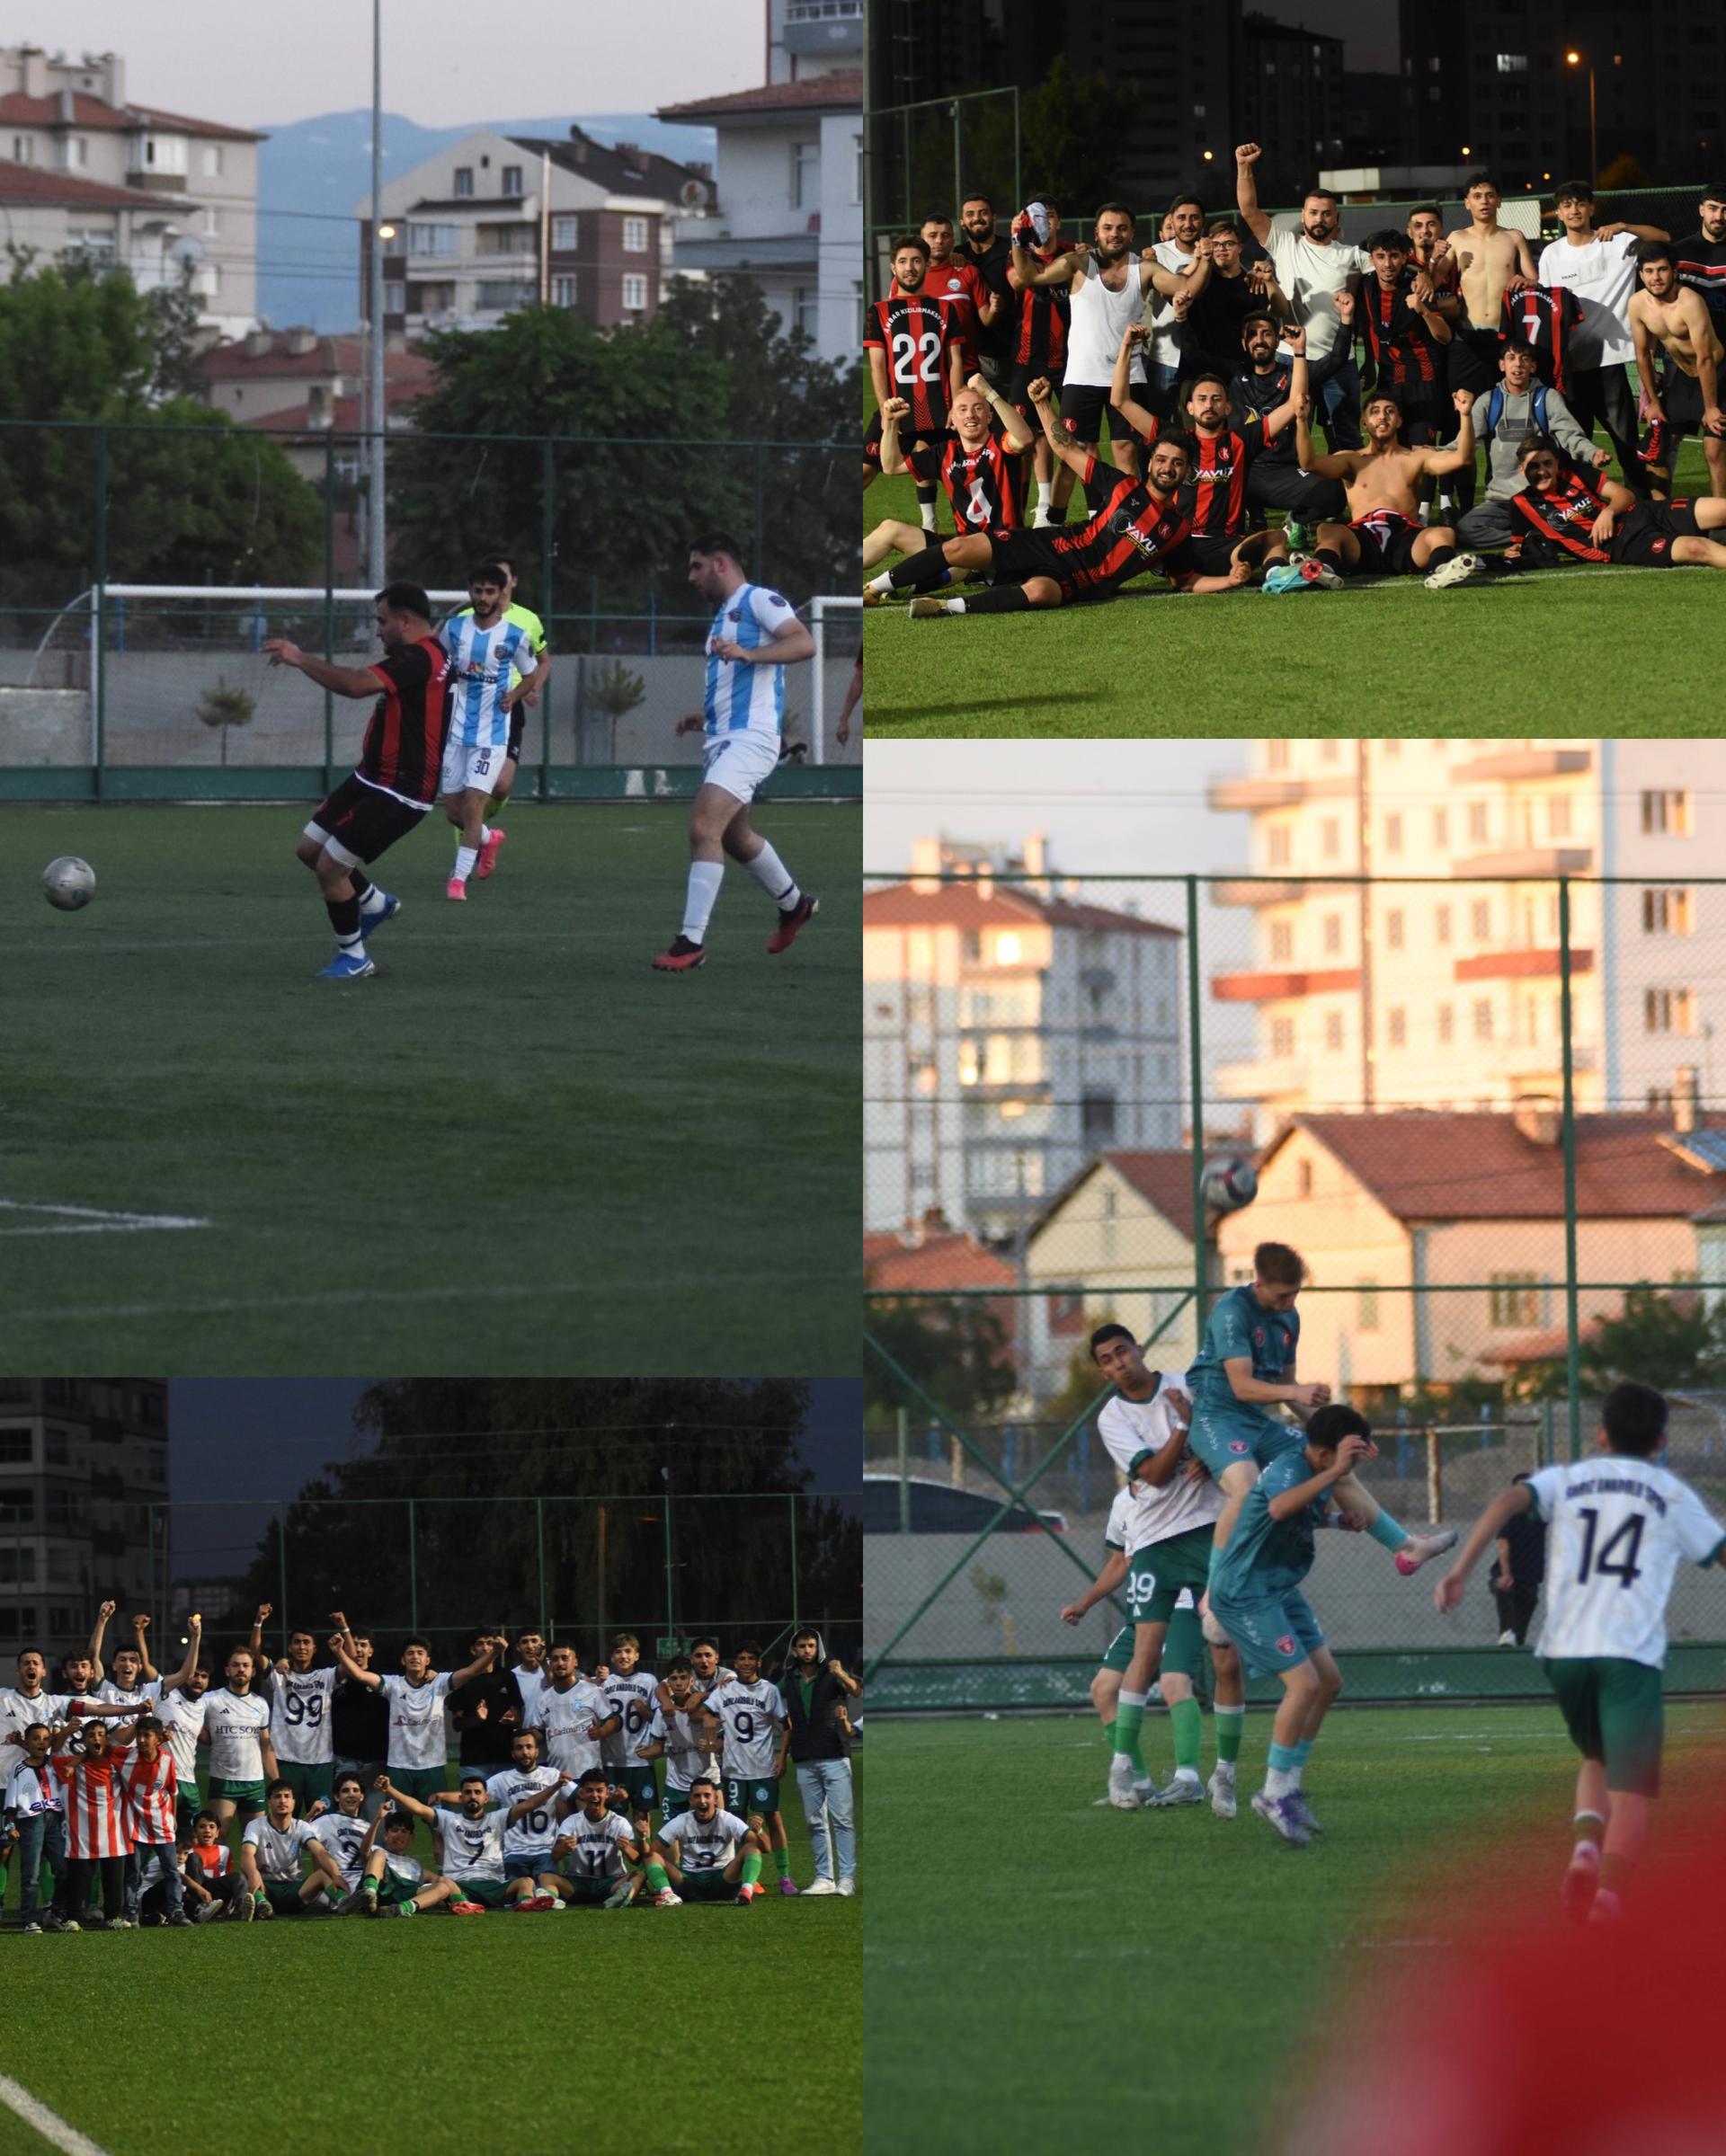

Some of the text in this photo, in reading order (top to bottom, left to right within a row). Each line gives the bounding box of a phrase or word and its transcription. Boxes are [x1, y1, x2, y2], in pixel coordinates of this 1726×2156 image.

[1522, 315, 1541, 345] 7
[893, 332, 941, 384] 22
[475, 759, 490, 776] 30
[1577, 1507, 1645, 1589] 14
[285, 1692, 323, 1727] 99
[216, 1726, 237, 1735] HTC
[734, 1711, 753, 1743] 9
[729, 1781, 738, 1798] 9
[465, 1841, 485, 1865] 7
